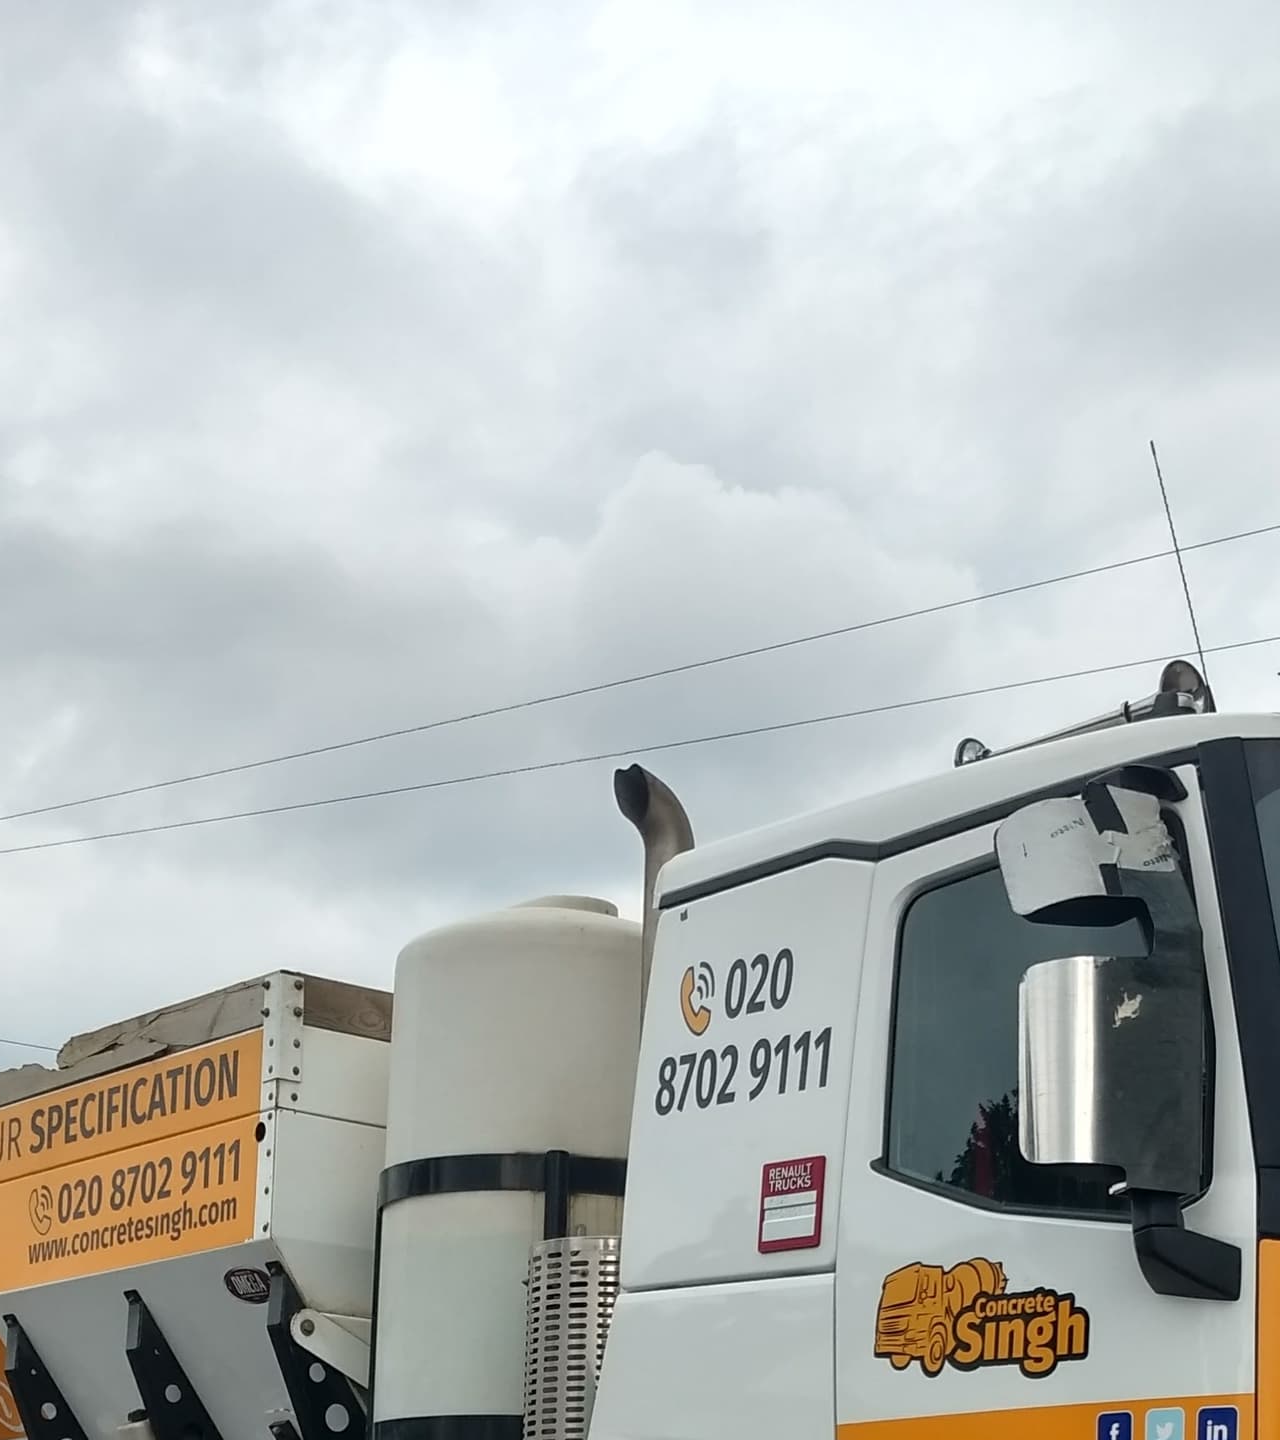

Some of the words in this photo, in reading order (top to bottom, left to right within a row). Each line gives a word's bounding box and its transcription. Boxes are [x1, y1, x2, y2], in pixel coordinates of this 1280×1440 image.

[725, 948, 794, 1019] 020
[29, 1050, 240, 1153] SPECIFICATION
[655, 1044, 739, 1116] 8702
[749, 1026, 832, 1101] 9111
[58, 1175, 103, 1224] 020
[109, 1157, 172, 1212] 8702
[181, 1139, 241, 1196] 9111
[768, 1162, 813, 1181] RENAULT
[768, 1175, 812, 1193] TRUCKS
[28, 1197, 237, 1264] www.concretesingh.com
[953, 1300, 1086, 1373] Singh
[975, 1293, 1055, 1318] Concrete
